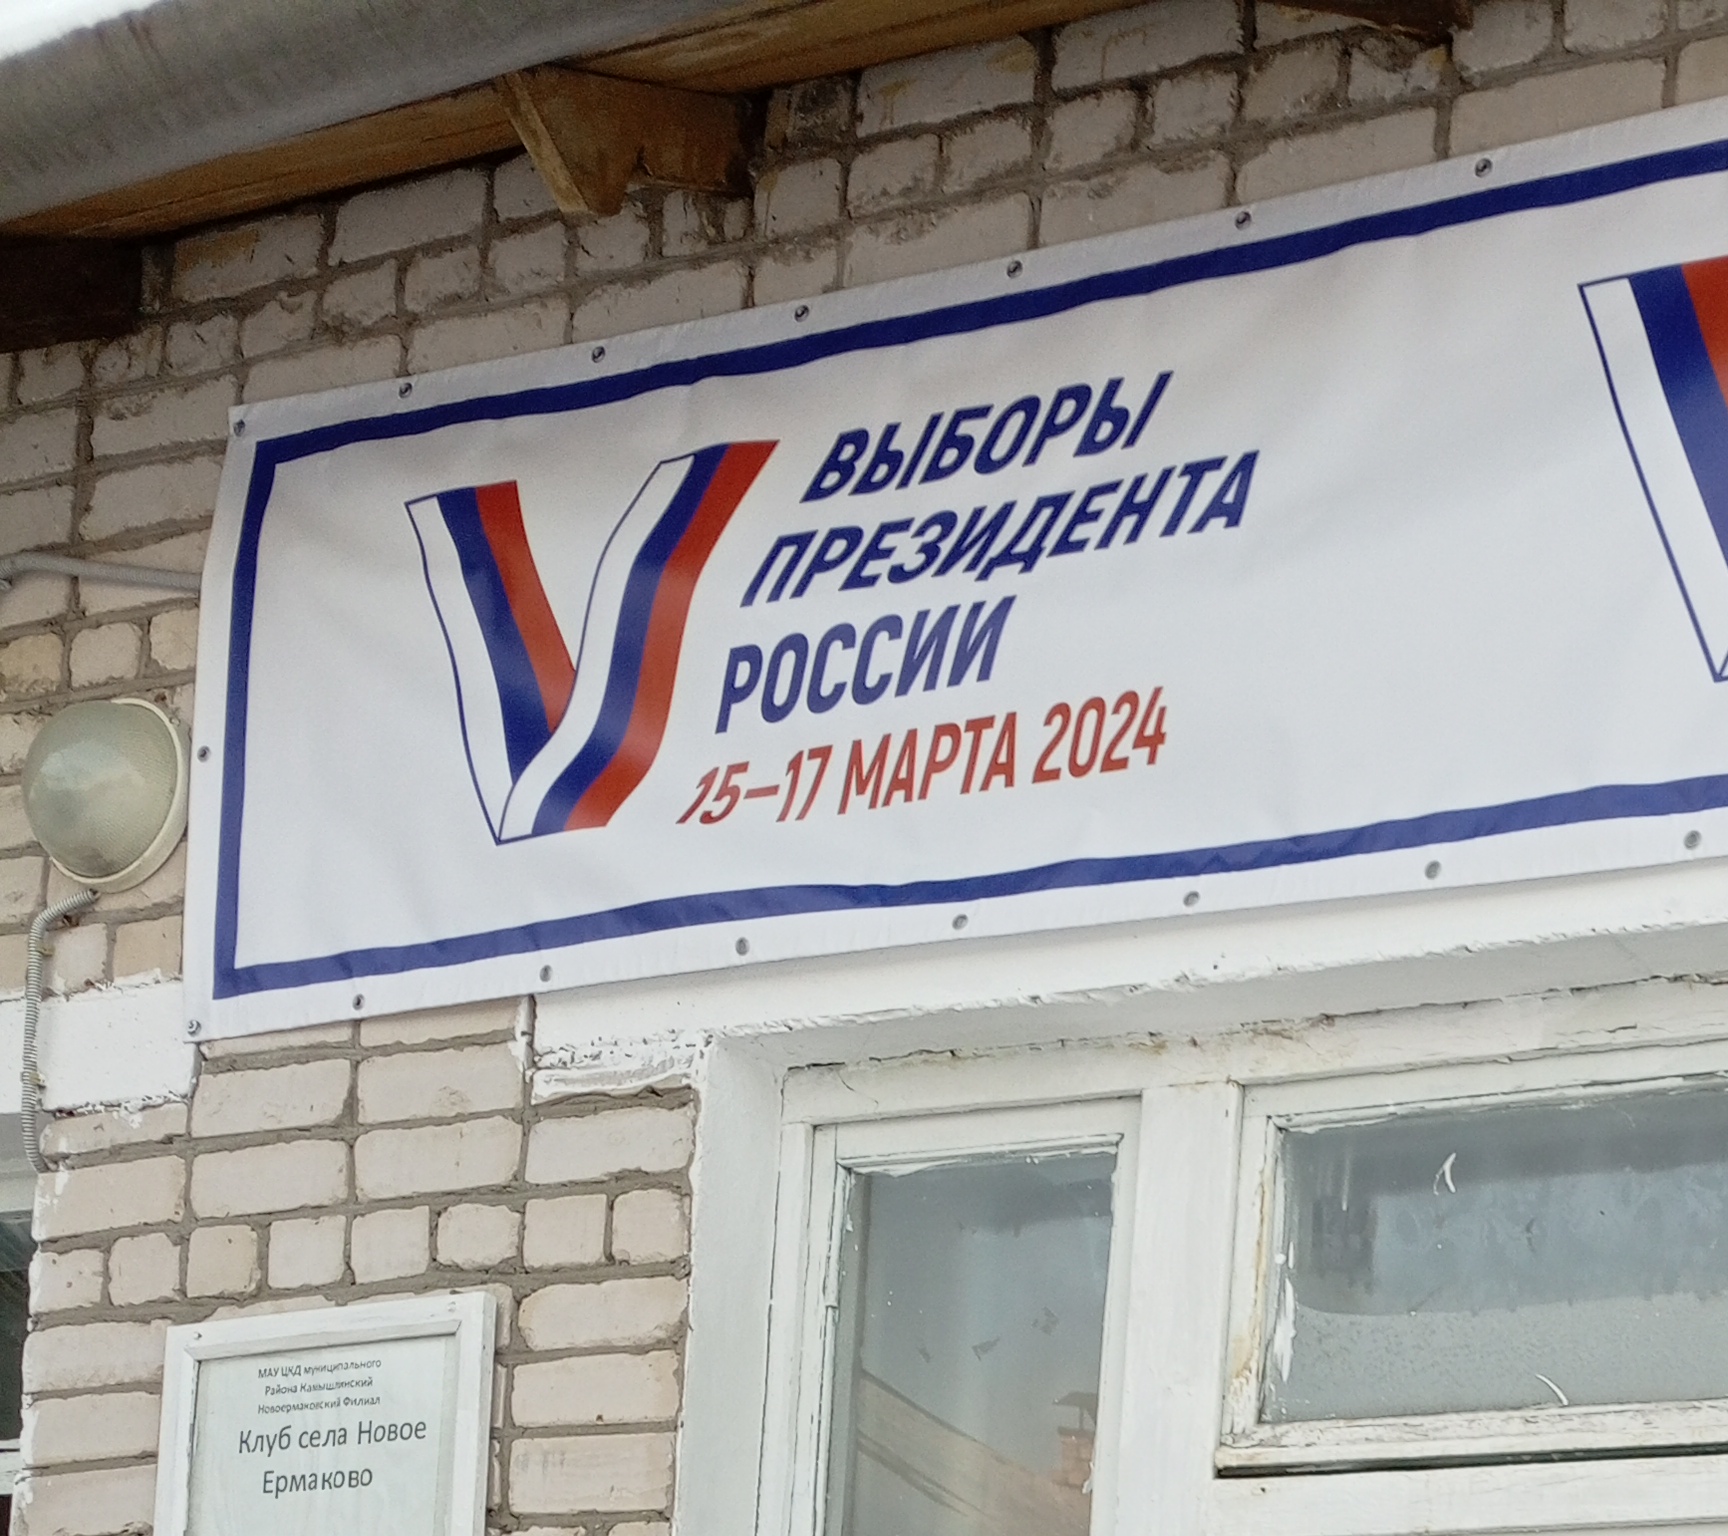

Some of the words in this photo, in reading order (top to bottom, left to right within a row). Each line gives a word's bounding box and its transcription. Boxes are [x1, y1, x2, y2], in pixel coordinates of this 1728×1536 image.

[799, 370, 1173, 504] ВЫБОРЫ
[740, 450, 1262, 608] ПРЕЗИДЕНТА
[715, 596, 1016, 735] РОССИИ
[842, 712, 1018, 817] МАРТА
[1031, 686, 1168, 785] 2024
[238, 1425, 292, 1458] Клуб
[298, 1426, 348, 1449] села
[357, 1420, 427, 1445] Новое
[262, 1466, 373, 1500] Ермаково
